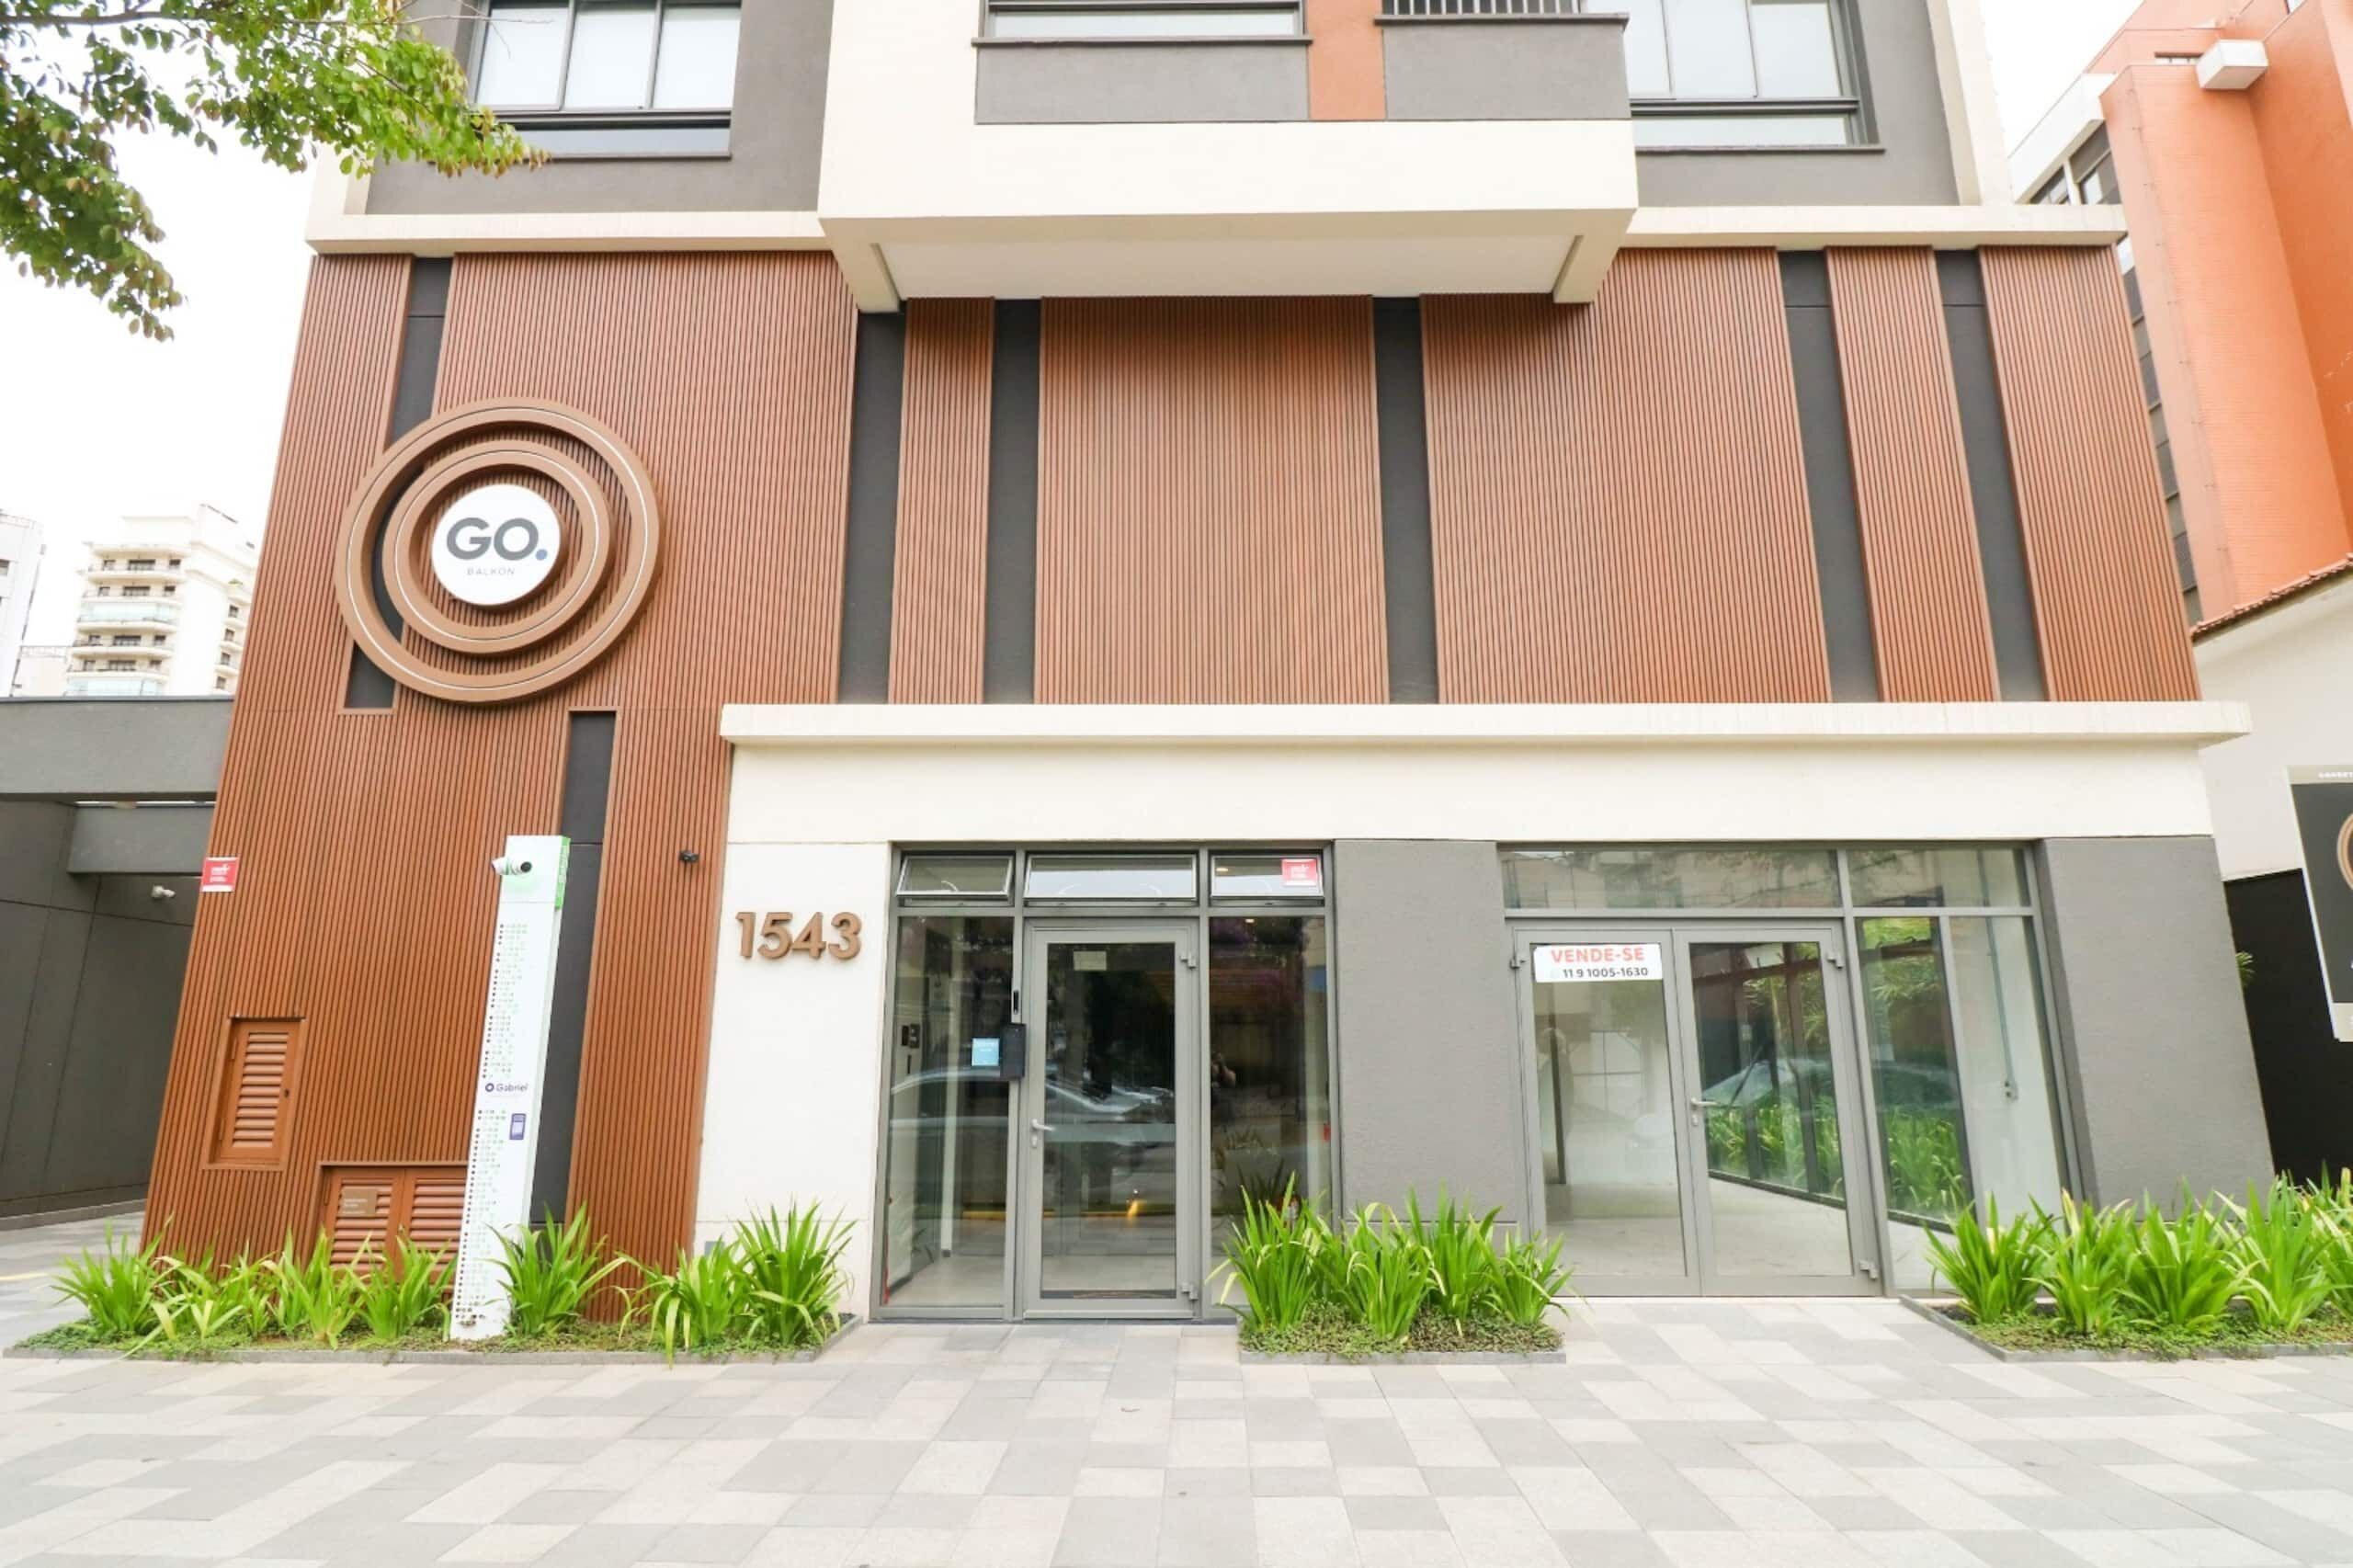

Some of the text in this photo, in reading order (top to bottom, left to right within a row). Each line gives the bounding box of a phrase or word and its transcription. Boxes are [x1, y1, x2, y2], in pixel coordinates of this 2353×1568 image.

[447, 517, 548, 561] GO.
[467, 567, 516, 576] BALKON
[735, 911, 863, 960] 1543
[1551, 948, 1644, 964] VENDE-SE
[1563, 967, 1649, 978] 11 9 1005-1630
[496, 1082, 529, 1092] Gabriel
